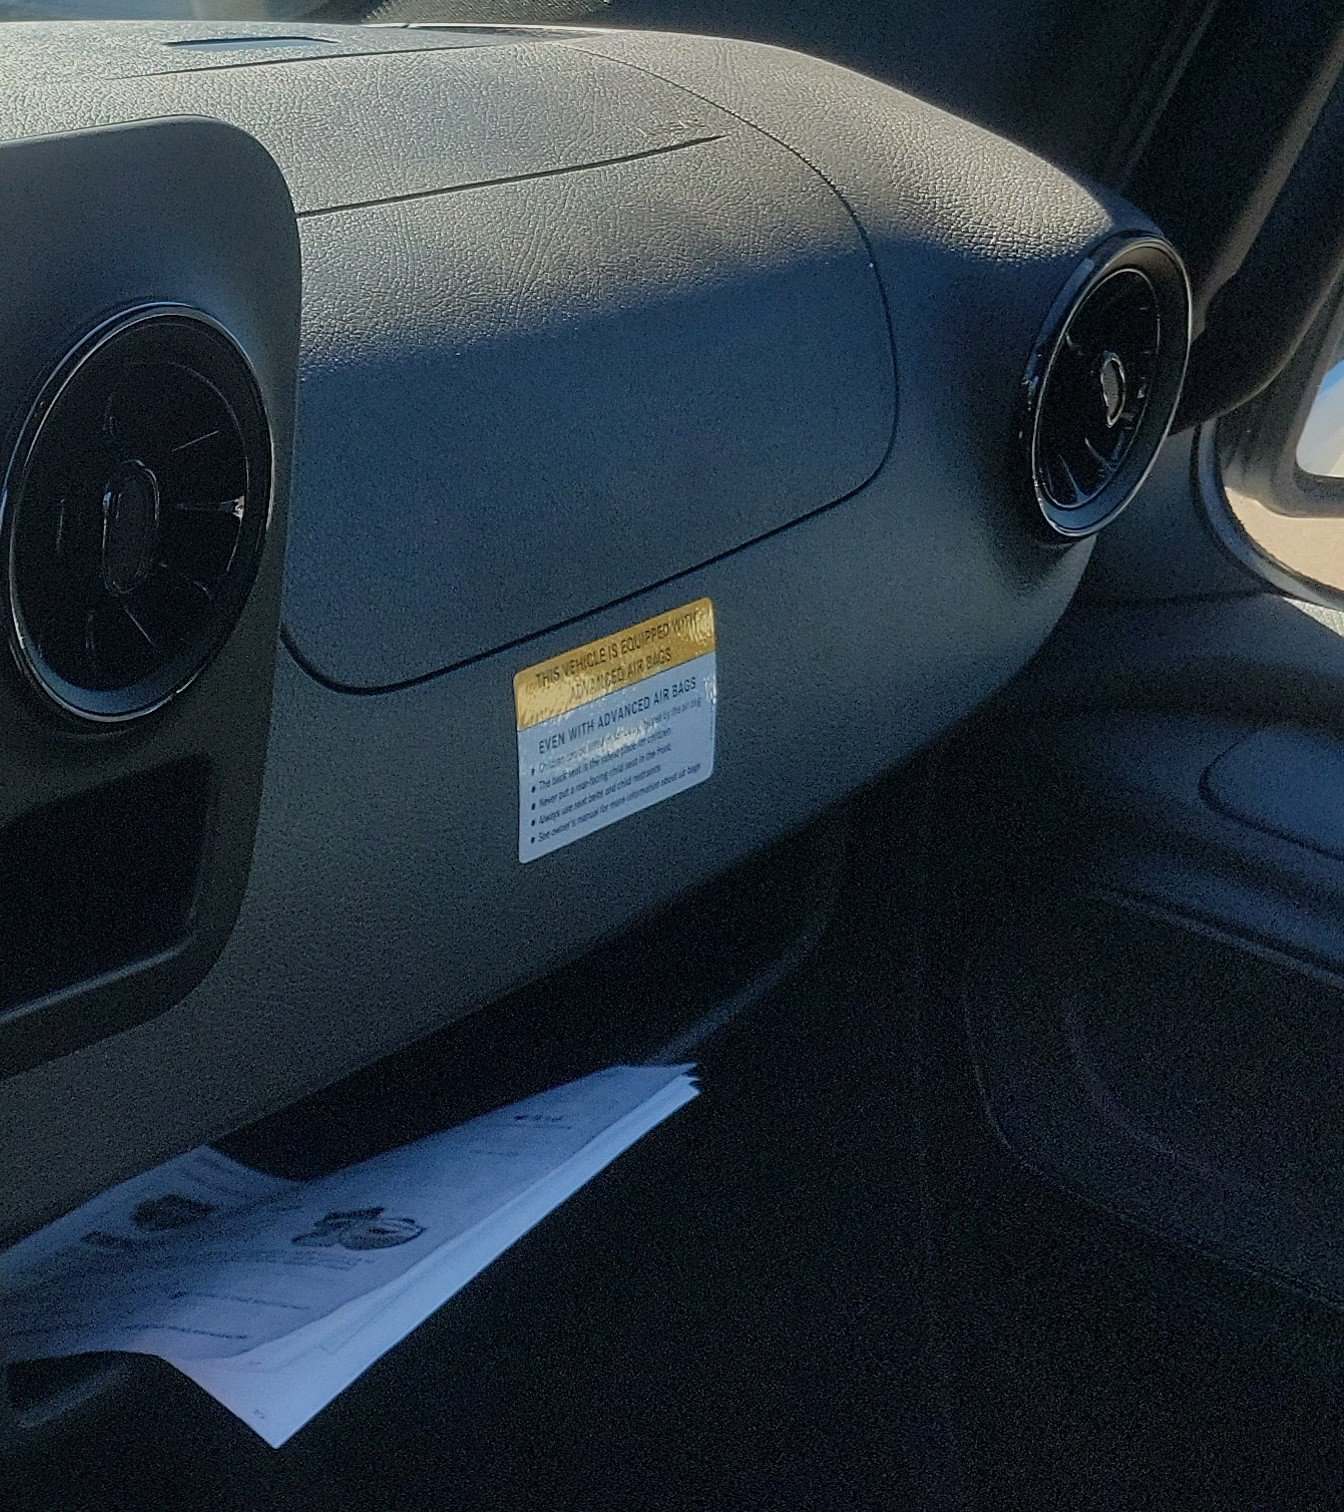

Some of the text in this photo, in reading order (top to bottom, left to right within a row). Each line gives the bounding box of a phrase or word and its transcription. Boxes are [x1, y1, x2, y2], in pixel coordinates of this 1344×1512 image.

[535, 665, 560, 687] THIS
[562, 647, 606, 677] VEHICLE
[607, 642, 618, 659] IS
[620, 623, 669, 654] EQUIPPED
[569, 647, 671, 700] ADVANCED AIR BAGS
[538, 732, 564, 753] EVEN
[568, 719, 594, 741] WITH
[597, 696, 650, 729] ADVANCED
[653, 688, 669, 705] AIR
[671, 677, 696, 698] BAGS
